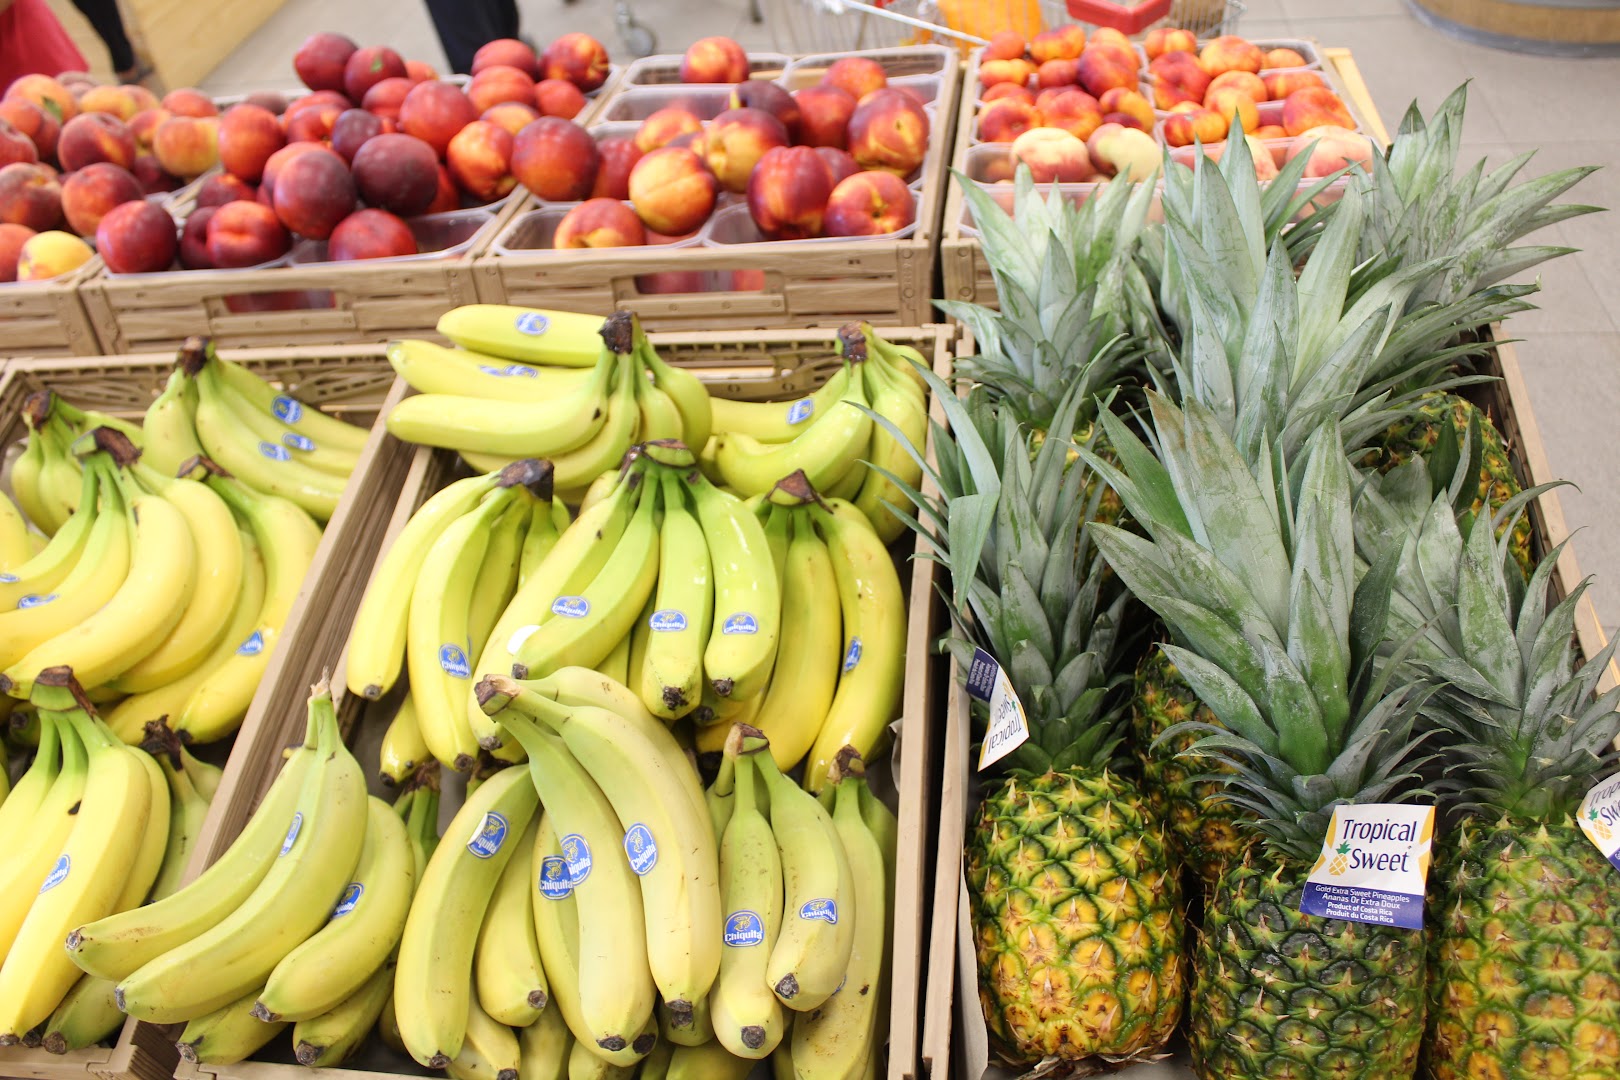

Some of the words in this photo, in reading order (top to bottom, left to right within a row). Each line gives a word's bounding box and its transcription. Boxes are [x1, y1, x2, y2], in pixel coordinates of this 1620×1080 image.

[551, 605, 587, 616] Chiquita
[650, 621, 685, 629] Chiquita
[723, 624, 757, 634] Chiquita
[1343, 818, 1418, 843] Tropical
[630, 843, 656, 871] Chiquita
[1349, 848, 1410, 873] Sweet
[539, 880, 573, 892] Chiquita
[1315, 884, 1331, 893] Gold
[1332, 886, 1349, 895] Extra
[1350, 888, 1371, 898] Sweet
[1372, 891, 1410, 903] Pineapples
[1322, 893, 1349, 903] Ananas
[1350, 896, 1360, 904] Or
[1360, 898, 1380, 907] Extra
[1381, 900, 1401, 909] Doux
[801, 908, 836, 922] Chiquita
[1327, 902, 1352, 911] Product
[1360, 906, 1378, 915] Costa
[1379, 908, 1393, 916] Rica
[1326, 909, 1350, 918] Produit
[1350, 911, 1359, 919] du
[1360, 913, 1379, 922] Costa
[1379, 915, 1394, 924] Rica
[724, 929, 763, 942] Chiquita
